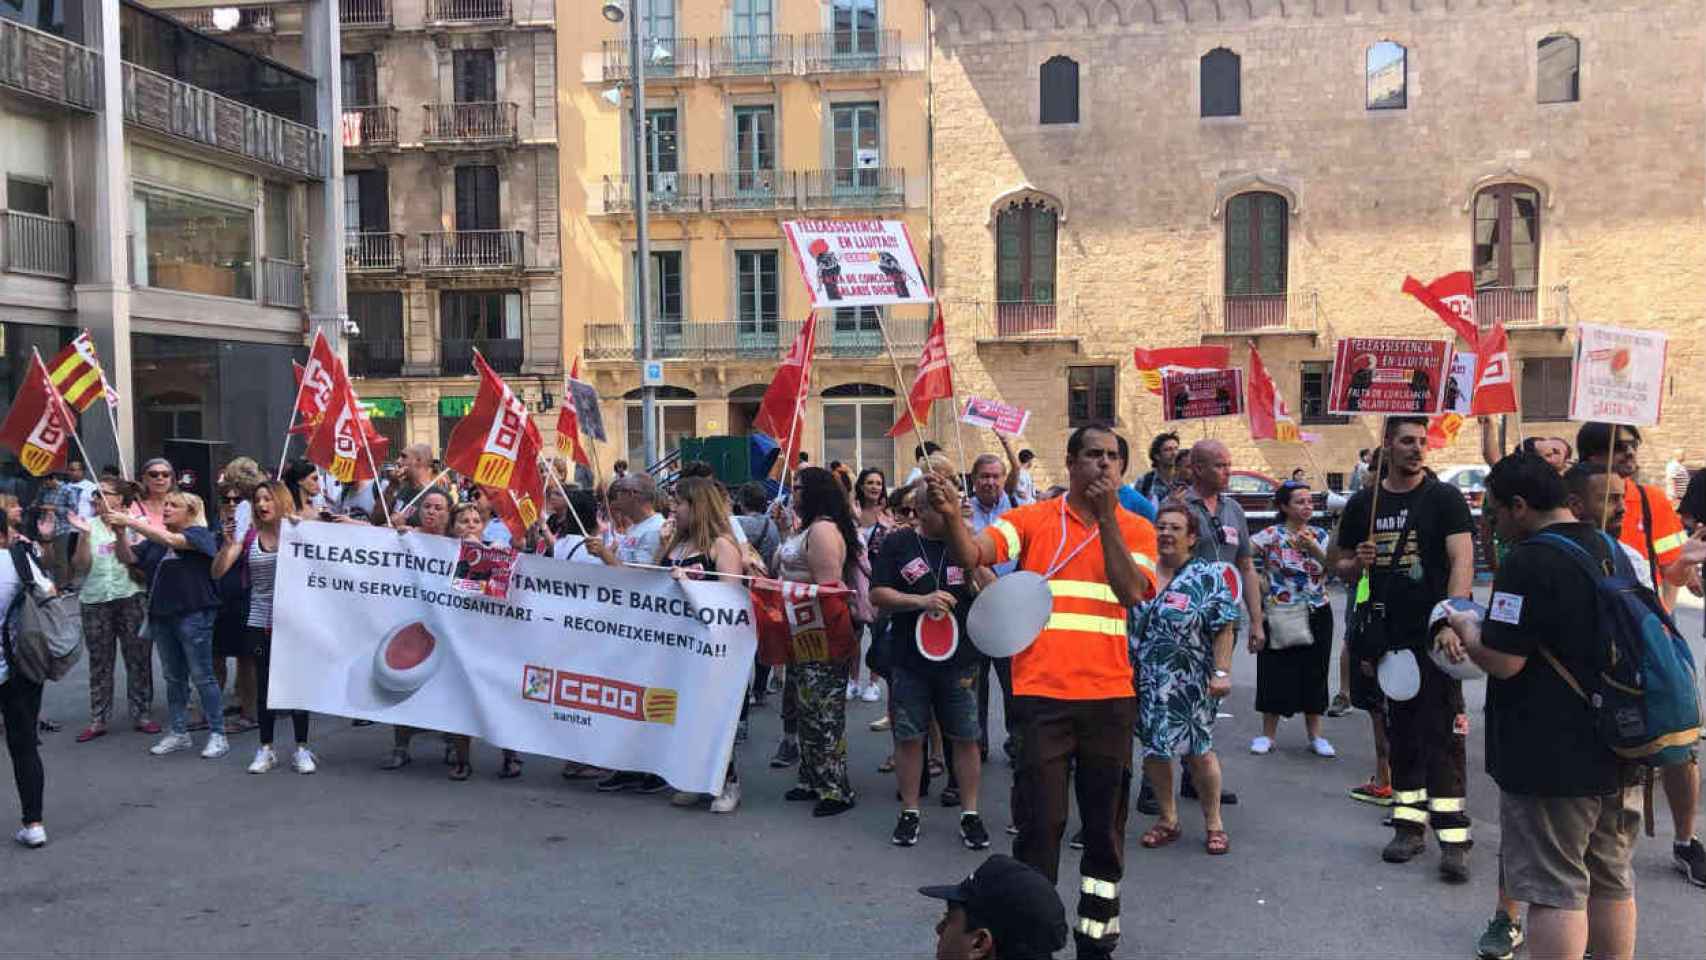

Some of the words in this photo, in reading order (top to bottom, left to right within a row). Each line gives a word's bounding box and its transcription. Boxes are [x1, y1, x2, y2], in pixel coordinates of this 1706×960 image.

[511, 575, 590, 600] TAMENT
[597, 587, 623, 606] DE
[307, 572, 327, 588] ÉS
[331, 578, 354, 592] UN
[359, 581, 418, 599] SERVEI
[420, 589, 533, 622] SOCIOSANITARI
[563, 615, 695, 650] RECONEIXEMENT
[695, 639, 728, 658] JA!!
[560, 679, 638, 713] CCOO
[553, 710, 592, 727] sanitat
